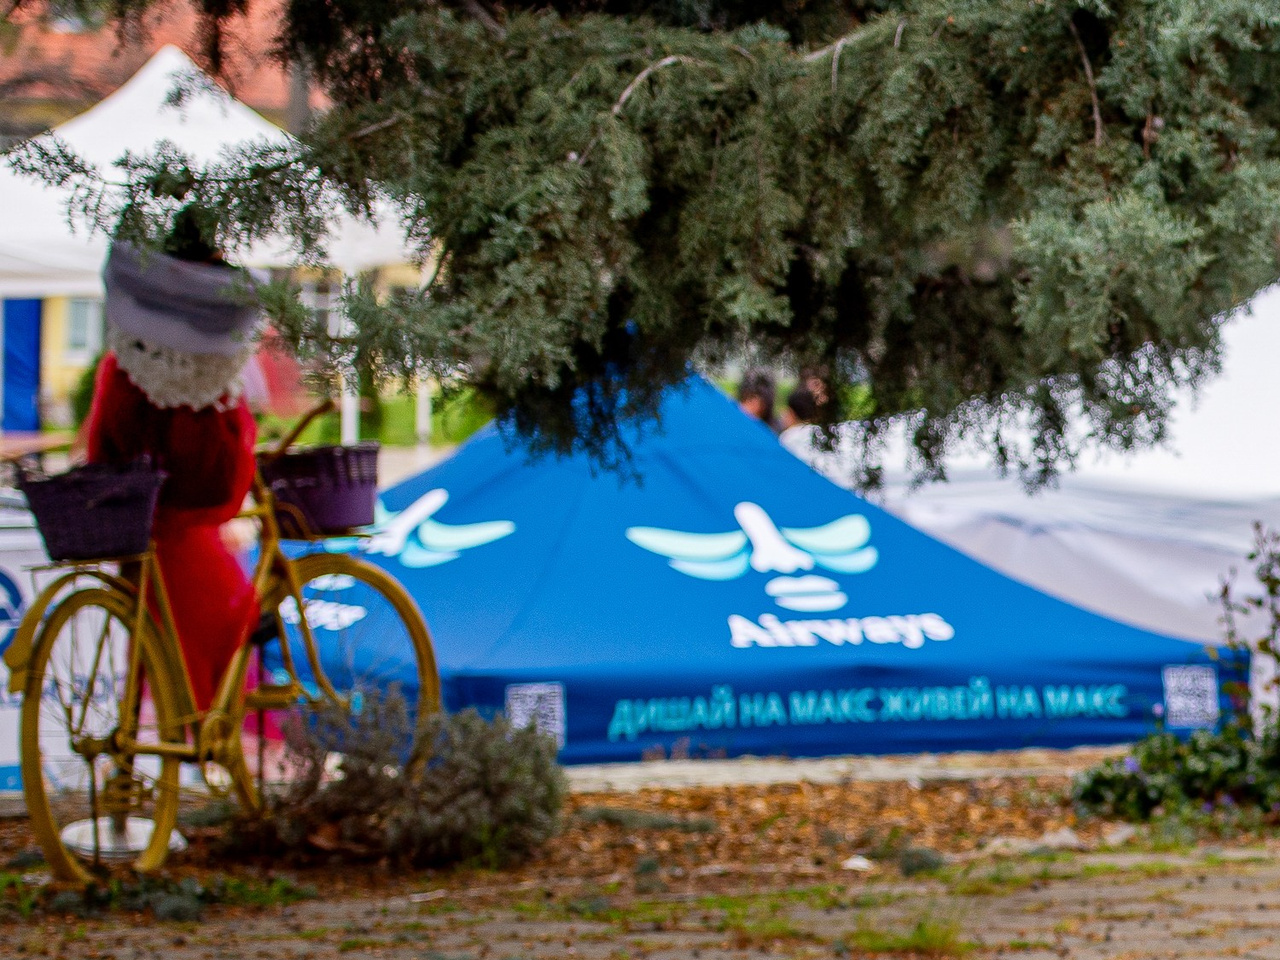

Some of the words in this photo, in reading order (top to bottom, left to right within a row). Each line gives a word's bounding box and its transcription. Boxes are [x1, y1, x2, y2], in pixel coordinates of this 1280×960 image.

[727, 612, 955, 648] Airways
[607, 684, 737, 742] ДИШАЙ
[739, 691, 788, 727] НА
[788, 687, 874, 725] МАКС
[878, 675, 993, 721] ЖИВЕЙ
[996, 685, 1042, 719] НА
[1042, 684, 1129, 718] МАКС
